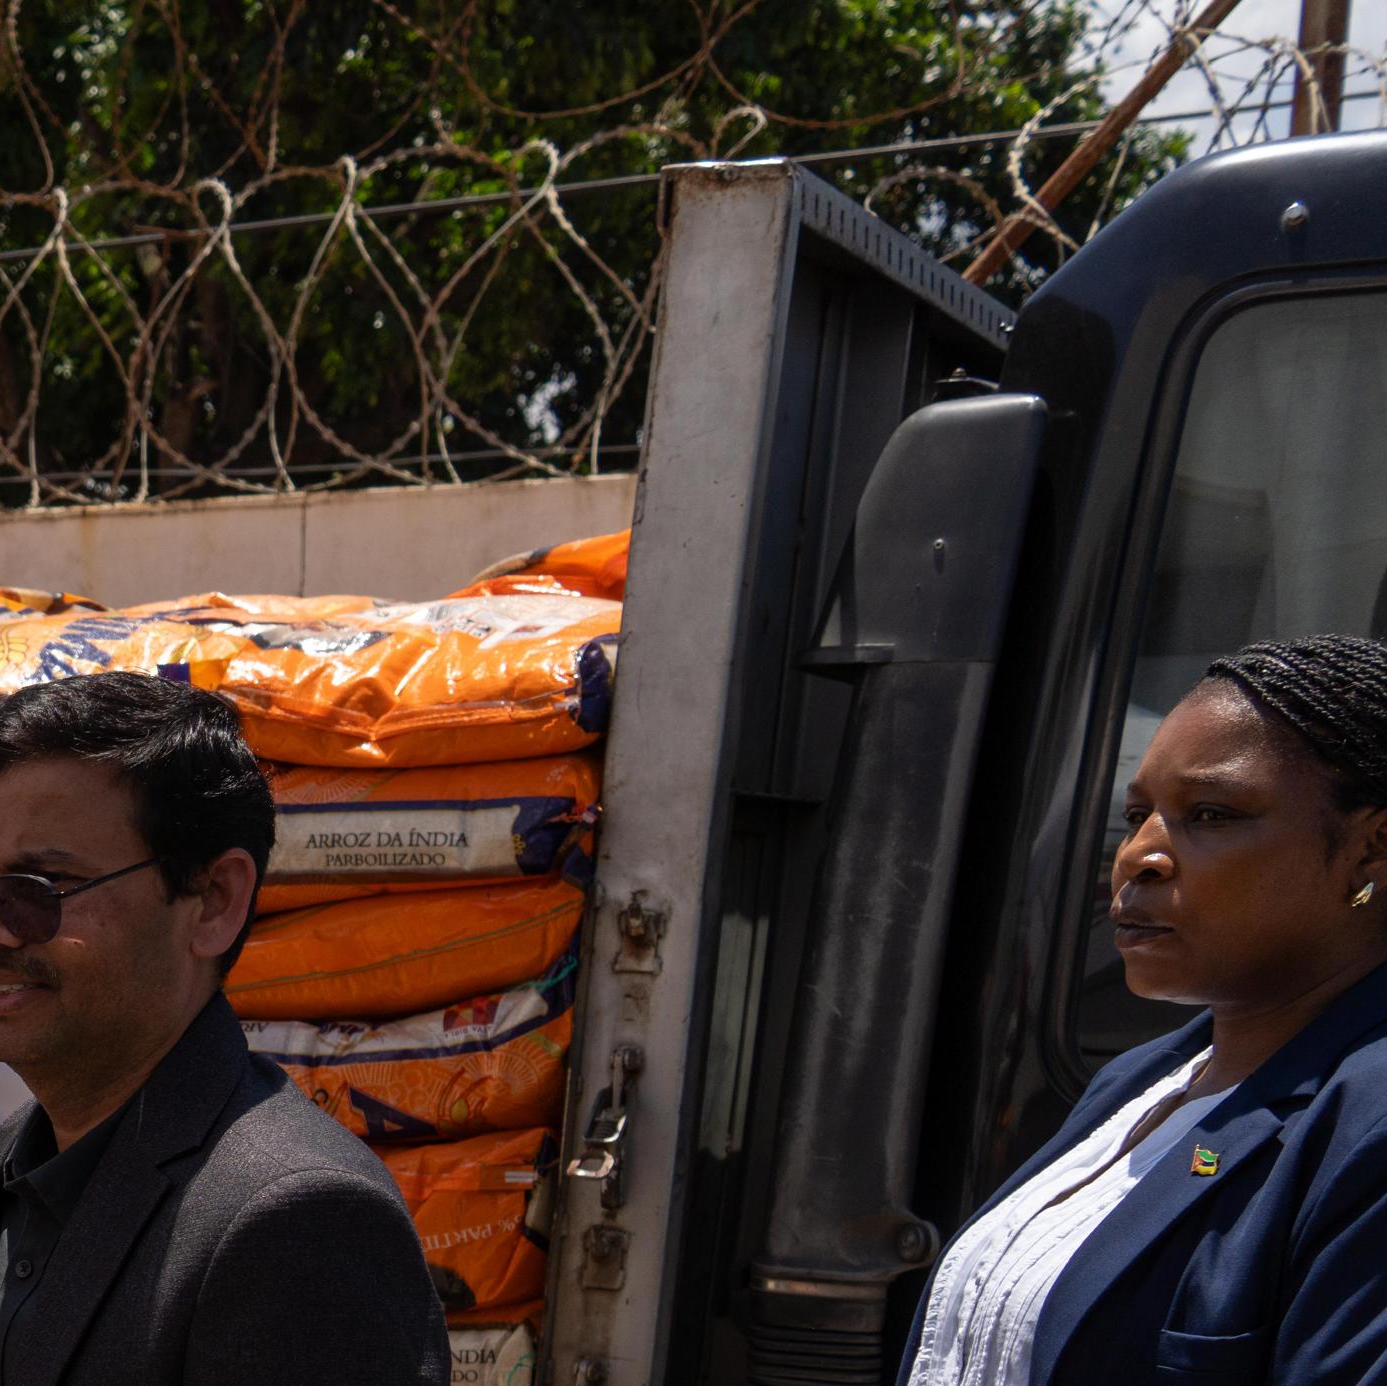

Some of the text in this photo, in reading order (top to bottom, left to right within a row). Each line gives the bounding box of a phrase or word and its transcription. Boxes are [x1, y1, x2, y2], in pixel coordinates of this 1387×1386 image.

[305, 828, 470, 850] ARROZ DA ÍNDIA
[326, 852, 447, 868] PARBOILIZADO
[451, 1349, 496, 1365] NDIA
